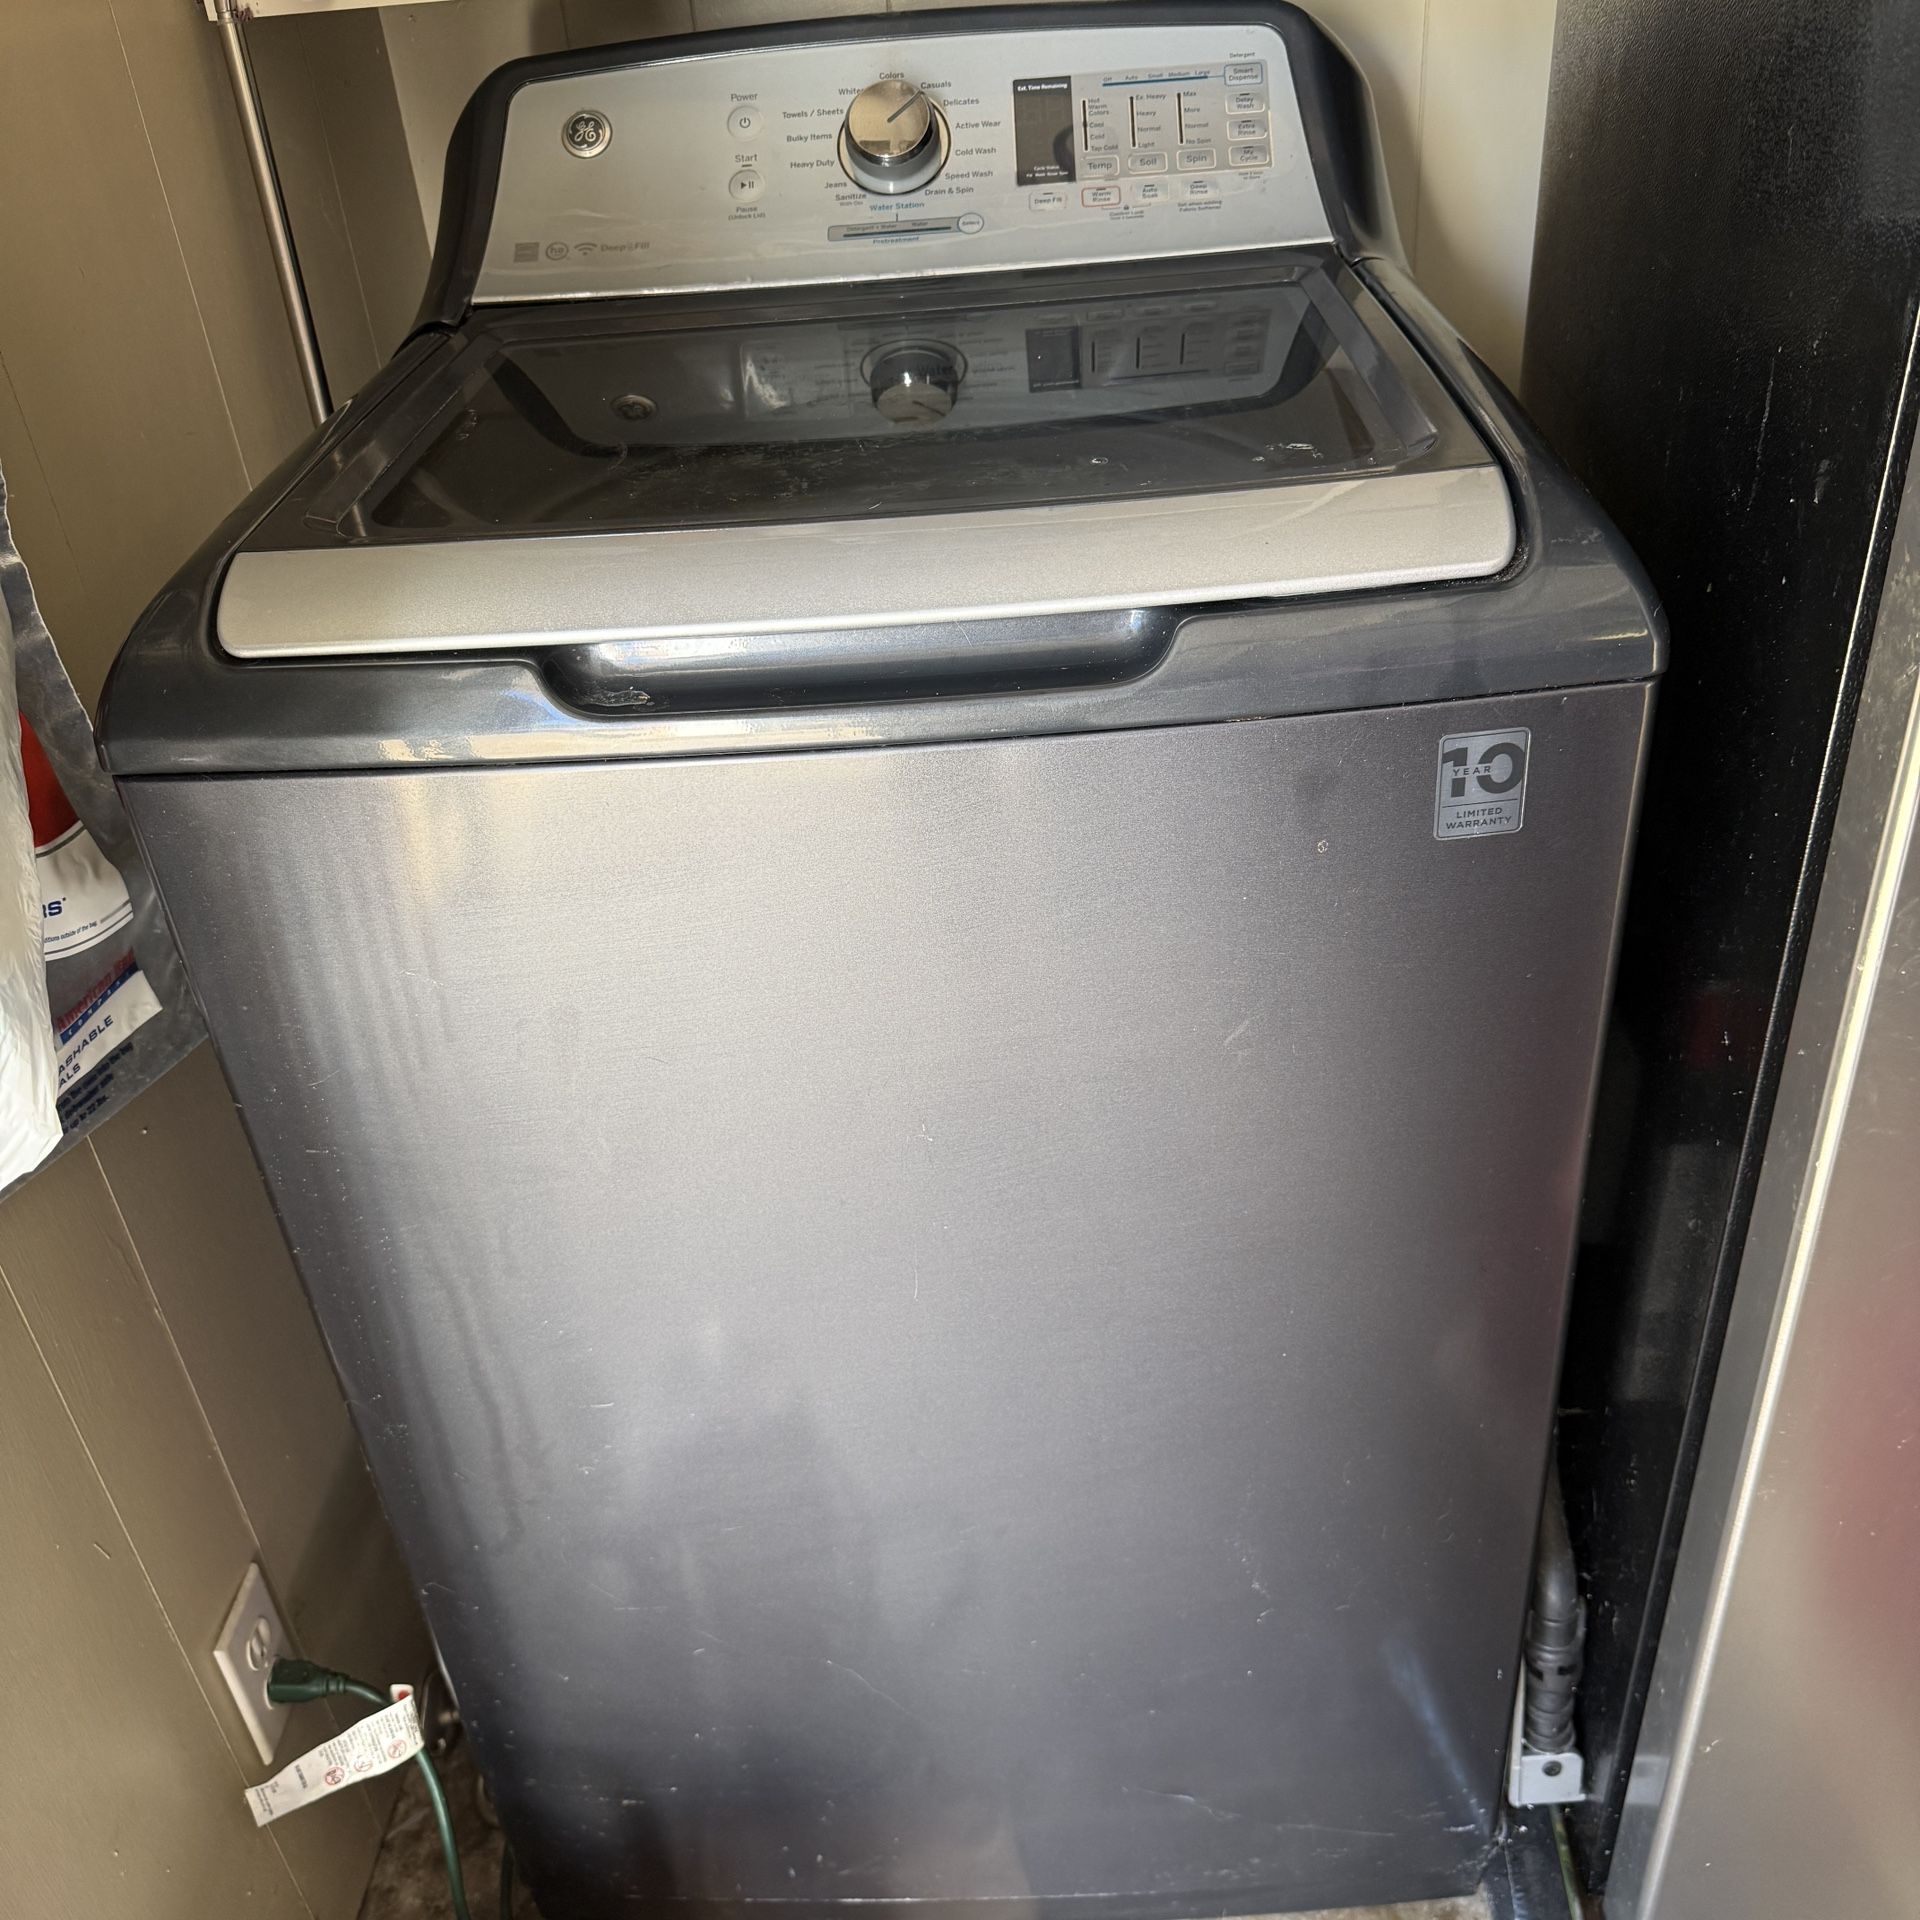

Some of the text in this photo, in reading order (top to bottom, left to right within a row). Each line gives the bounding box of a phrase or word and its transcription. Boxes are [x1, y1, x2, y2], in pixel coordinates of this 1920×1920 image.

[879, 71, 905, 80] Colors
[920, 80, 952, 90] Casuals
[730, 92, 758, 102] Power
[943, 97, 980, 107] Delicates
[782, 110, 808, 119] Towels
[816, 108, 844, 117] Sheets
[955, 120, 1001, 130] Active Wear
[786, 132, 832, 143] Bulky Items
[955, 146, 997, 157] Cold Wash
[735, 154, 758, 163] Start
[790, 158, 835, 169] Heavy Duty
[1139, 158, 1157, 166] Soil
[1186, 155, 1207, 164] Spin
[1088, 162, 1113, 171] Temp
[945, 170, 993, 182] Speed Wash
[824, 181, 847, 190] Jeans
[835, 192, 867, 201] Sanitize
[925, 186, 974, 197] Drain & Spin
[735, 205, 758, 213] Pause
[870, 201, 926, 211] Water Station
[872, 236, 919, 244] Pretreatment
[600, 242, 650, 252] Deep Fill
[1442, 742, 1525, 798] 10
[1453, 765, 1491, 776] YEAR
[1457, 807, 1503, 819] LIMITED
[1446, 816, 1512, 829] WARRANTY
